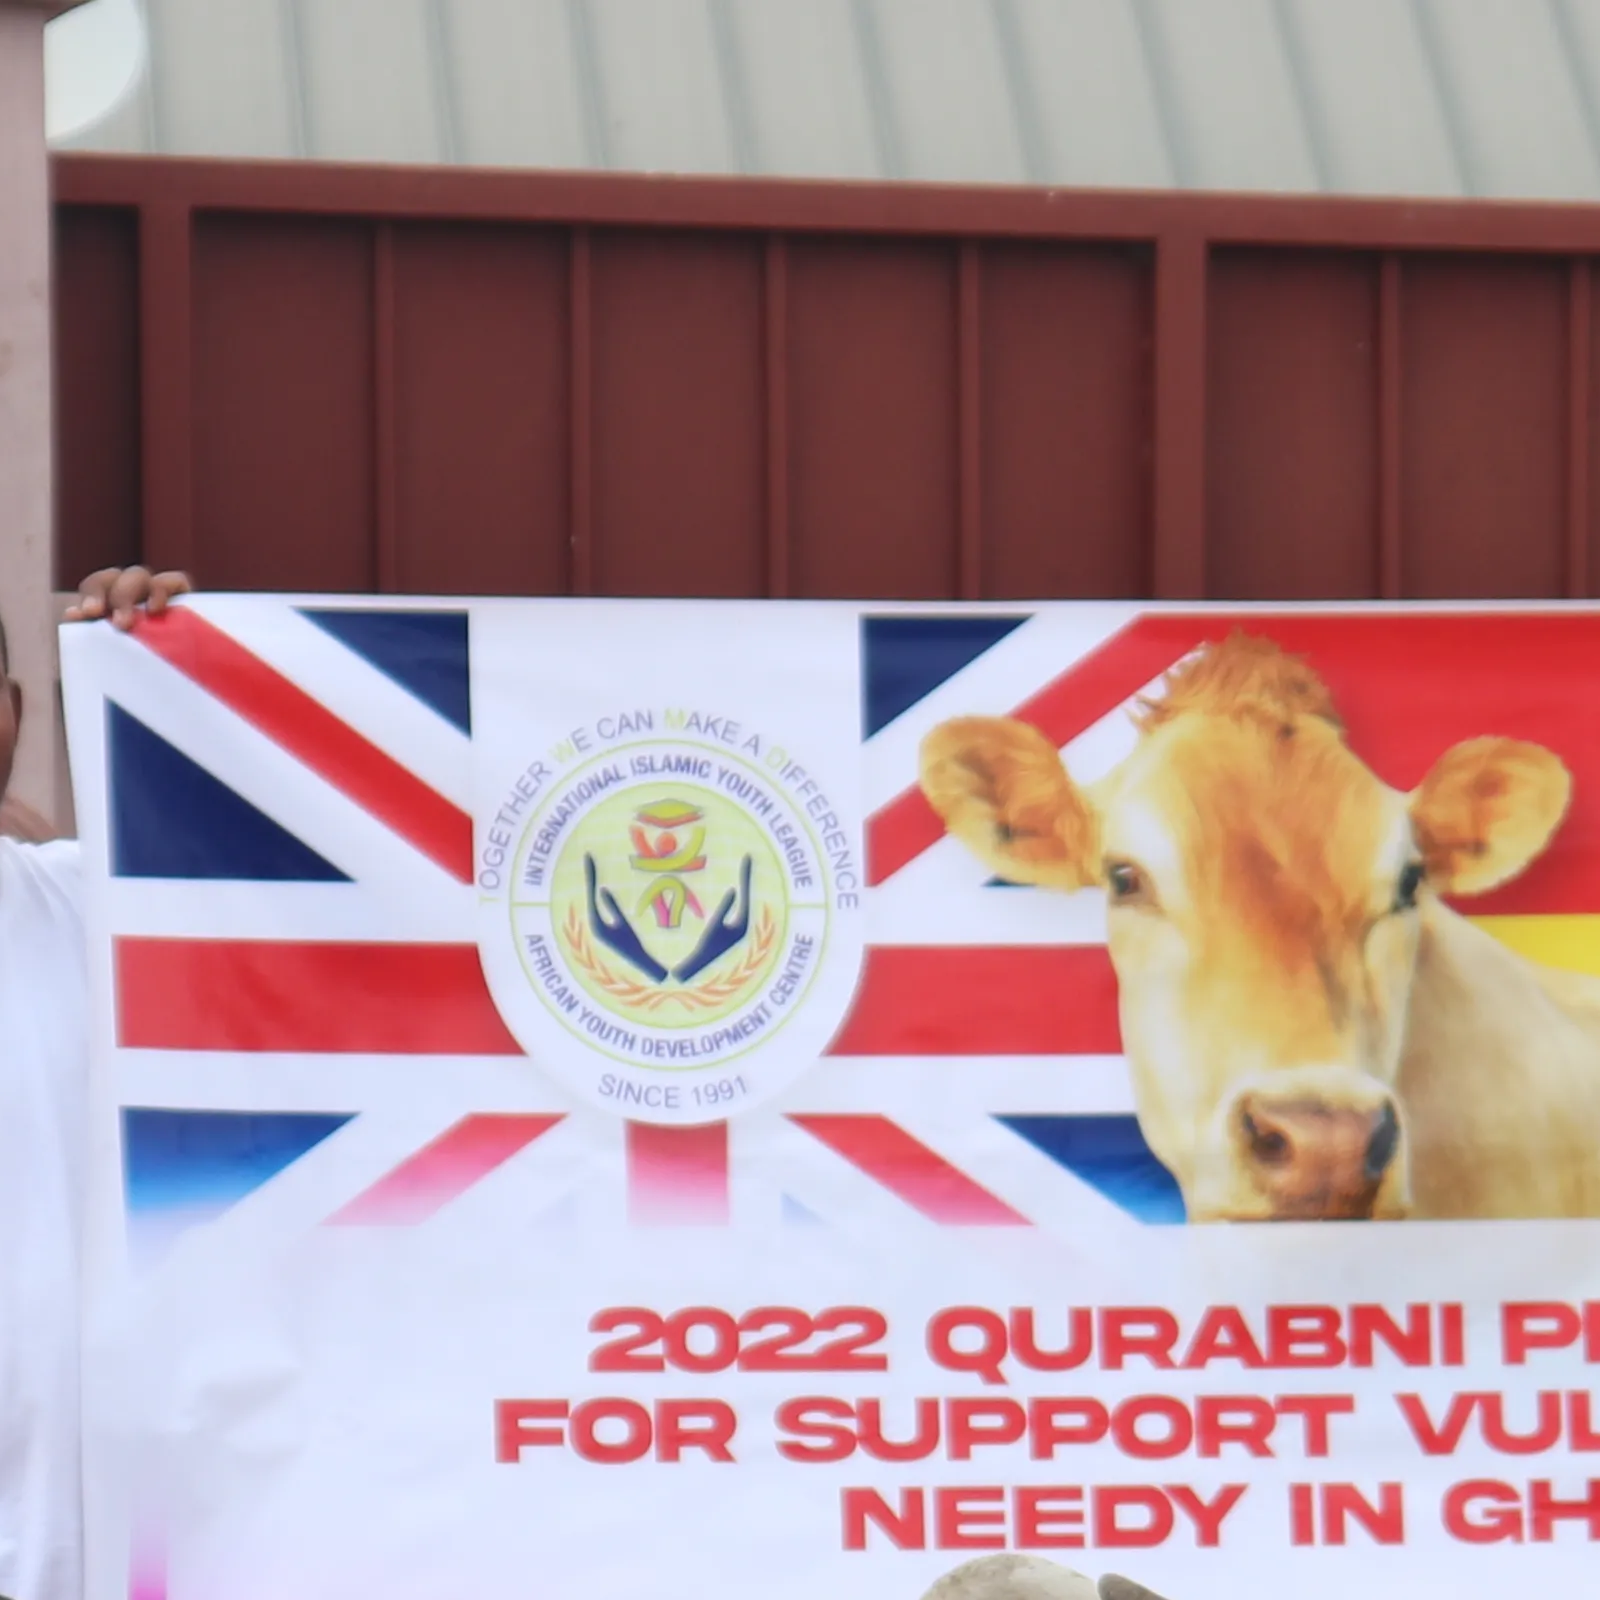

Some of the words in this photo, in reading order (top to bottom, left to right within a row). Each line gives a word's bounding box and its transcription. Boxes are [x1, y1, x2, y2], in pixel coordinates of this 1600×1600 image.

[478, 760, 552, 906] TOGETHER
[548, 727, 592, 763] WE
[597, 709, 653, 739] CAN
[664, 708, 741, 744] MAKE
[742, 733, 761, 757] A
[766, 745, 859, 910] DIFFERENCE
[524, 764, 627, 886] INTERNATIONAL
[630, 754, 711, 779] ISLAMIC
[716, 766, 774, 816] YOUTH
[768, 812, 813, 889] LEAGUE
[525, 933, 580, 1014] AFRICAN
[577, 1006, 638, 1052] YOUTH
[641, 1002, 773, 1058] DEVELOPMENT
[768, 933, 814, 1007] CENTRE
[597, 1072, 681, 1109] SINCE
[691, 1074, 749, 1107] 1991
[587, 1303, 889, 1374] 2022
[925, 1301, 1466, 1385] QURABNI
[493, 1396, 738, 1465] FOR
[774, 1392, 1355, 1464] SUPPORT
[840, 1482, 1248, 1551] NEEDY
[1289, 1480, 1404, 1546] IN
